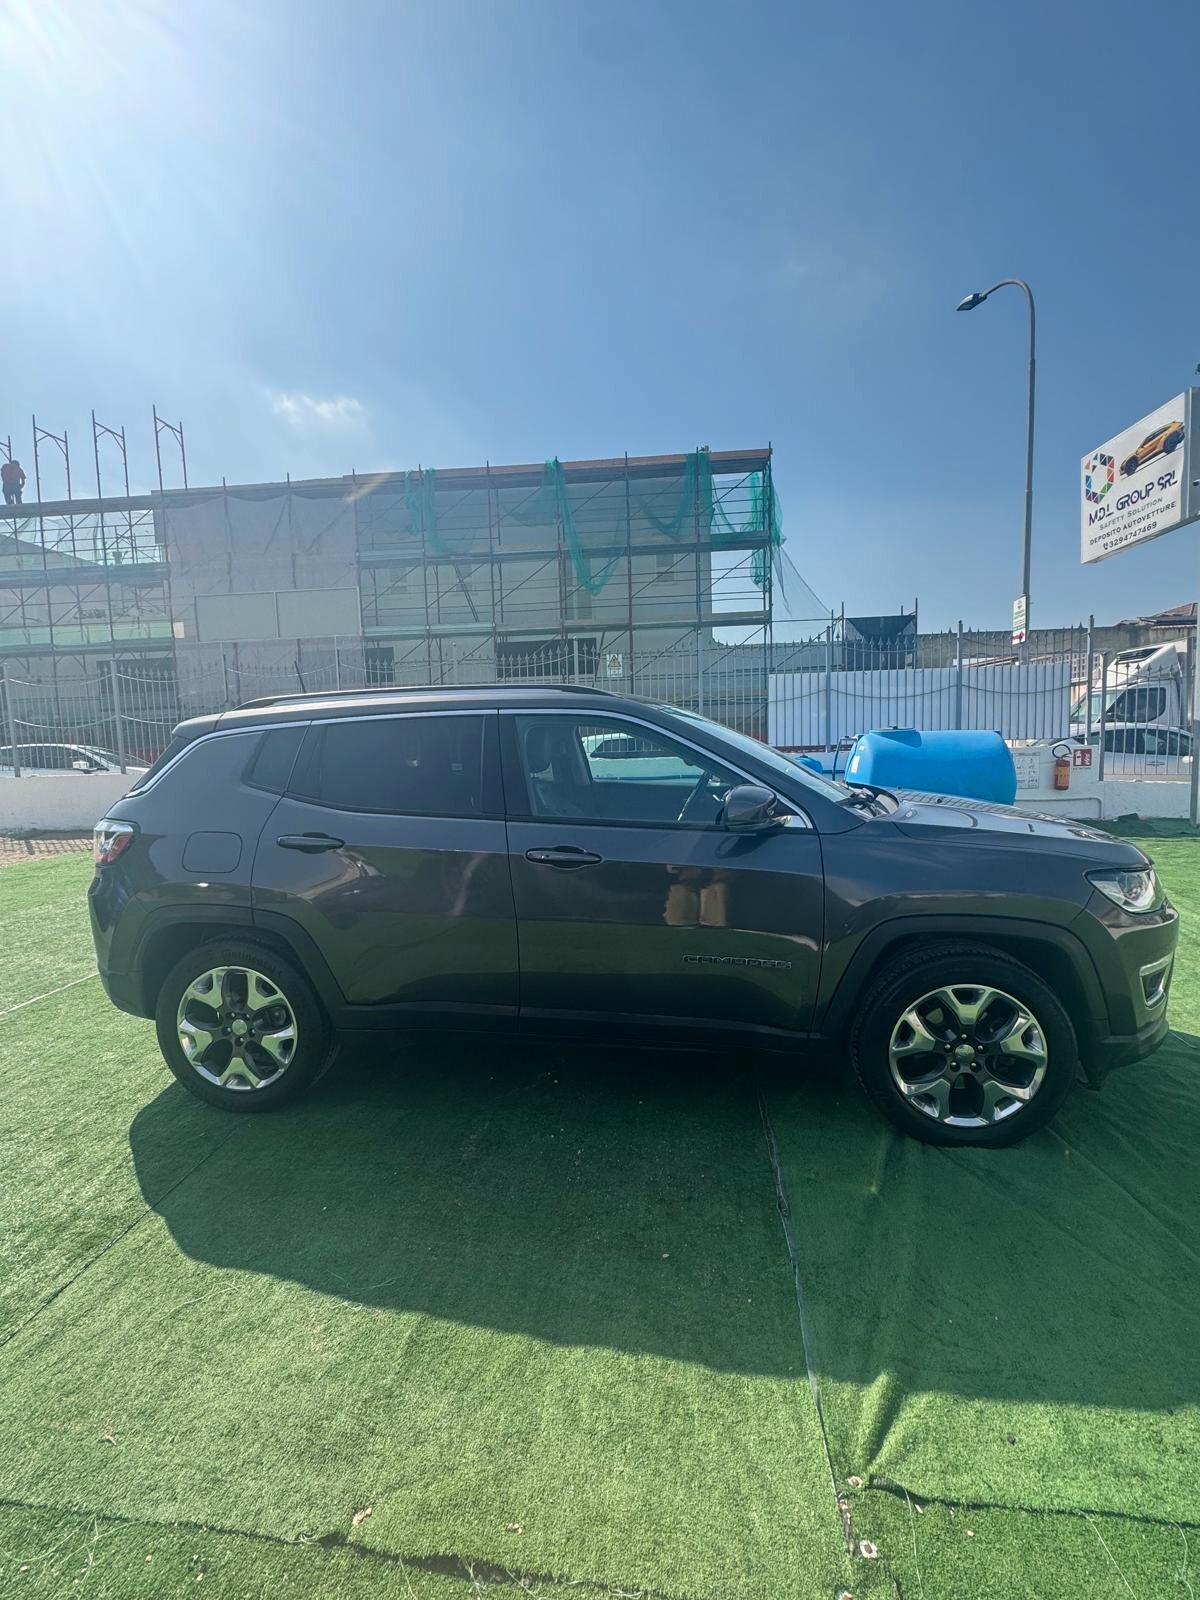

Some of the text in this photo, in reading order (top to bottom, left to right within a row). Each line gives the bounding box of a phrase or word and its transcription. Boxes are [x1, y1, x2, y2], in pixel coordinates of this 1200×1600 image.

[1116, 482, 1154, 511] GROUP
[1157, 470, 1178, 491] SRL
[1089, 501, 1177, 545] DEPOSITO AUTOVETTURE
[1099, 497, 1163, 531] SAFETY SOLUTION
[1109, 521, 1158, 548] 3294747469
